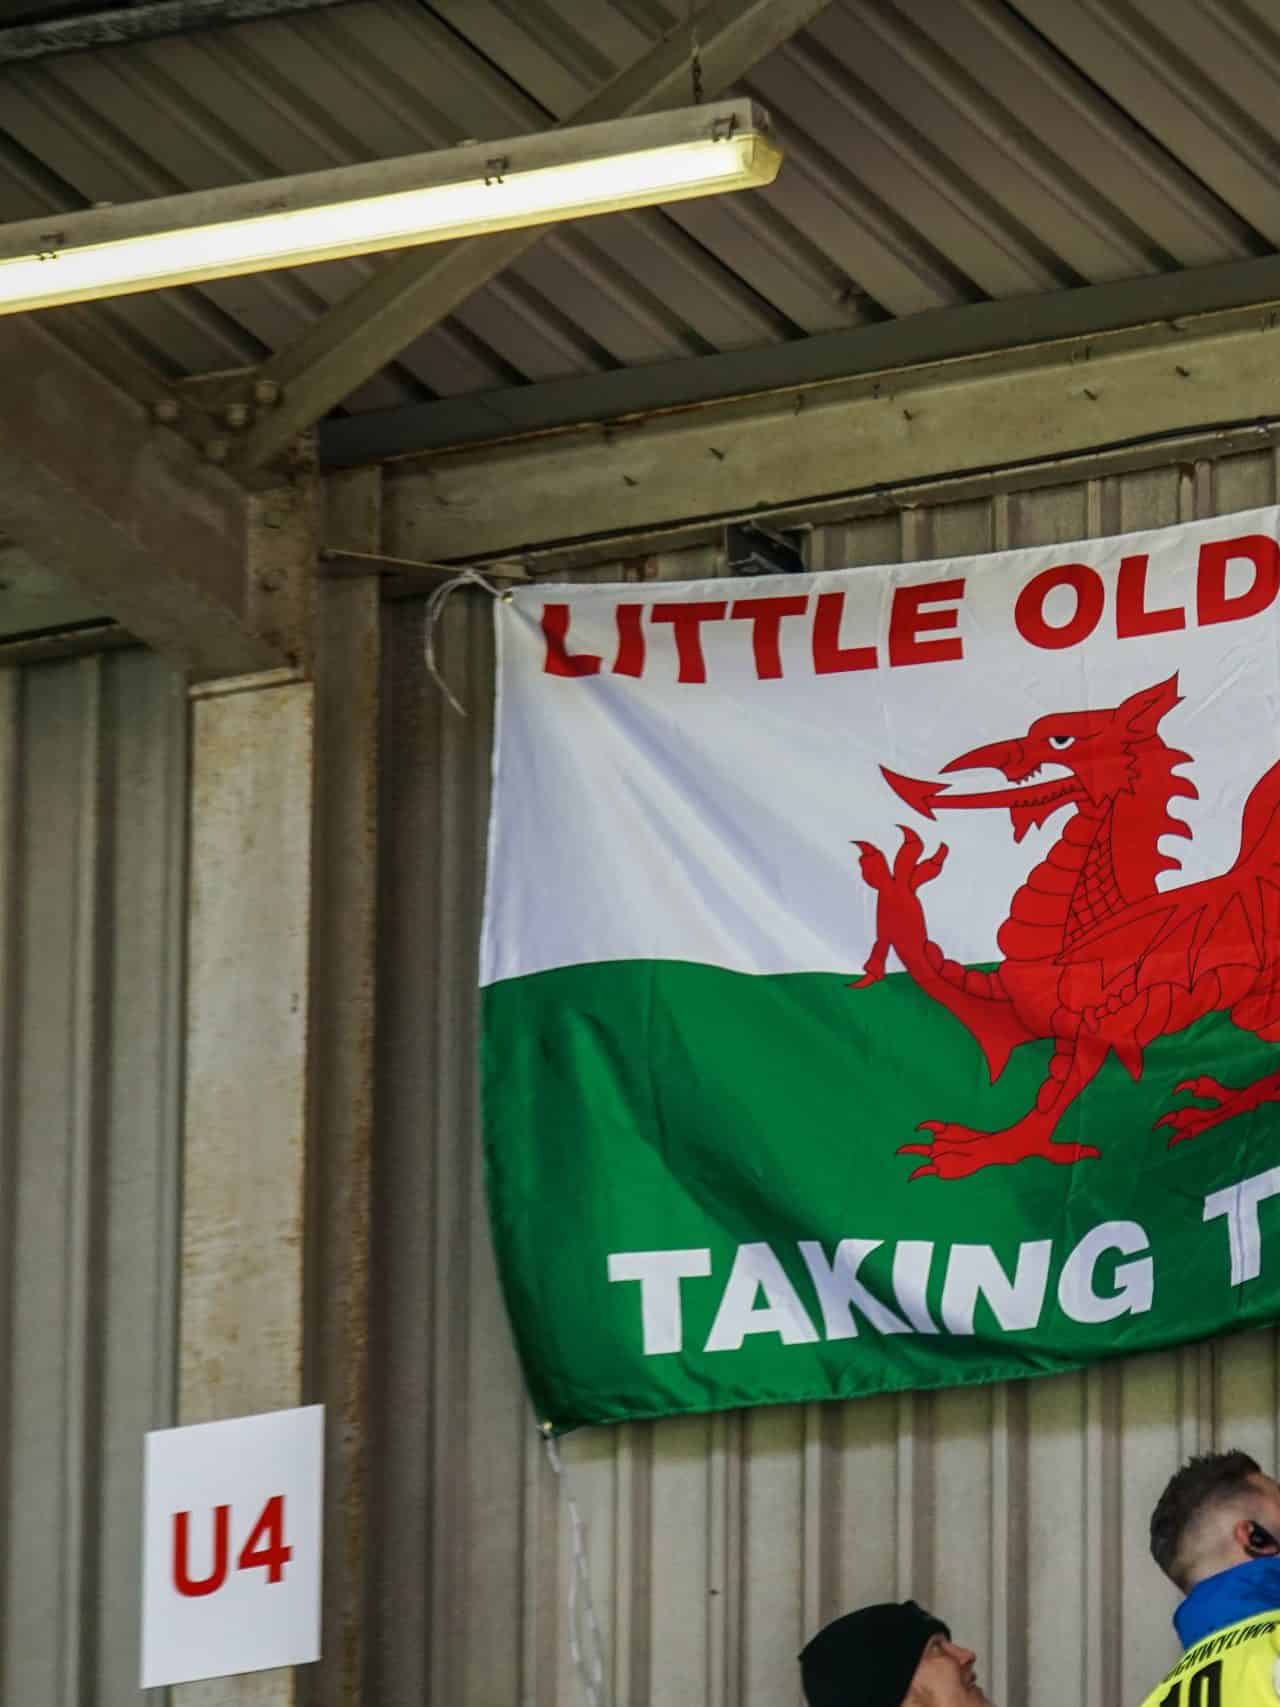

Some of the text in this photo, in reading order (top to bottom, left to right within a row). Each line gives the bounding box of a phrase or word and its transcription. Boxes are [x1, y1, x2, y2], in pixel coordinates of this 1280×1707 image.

[543, 577, 967, 684] LITTLE
[607, 1219, 1155, 1356] TAKING
[171, 1494, 294, 1598] U4
